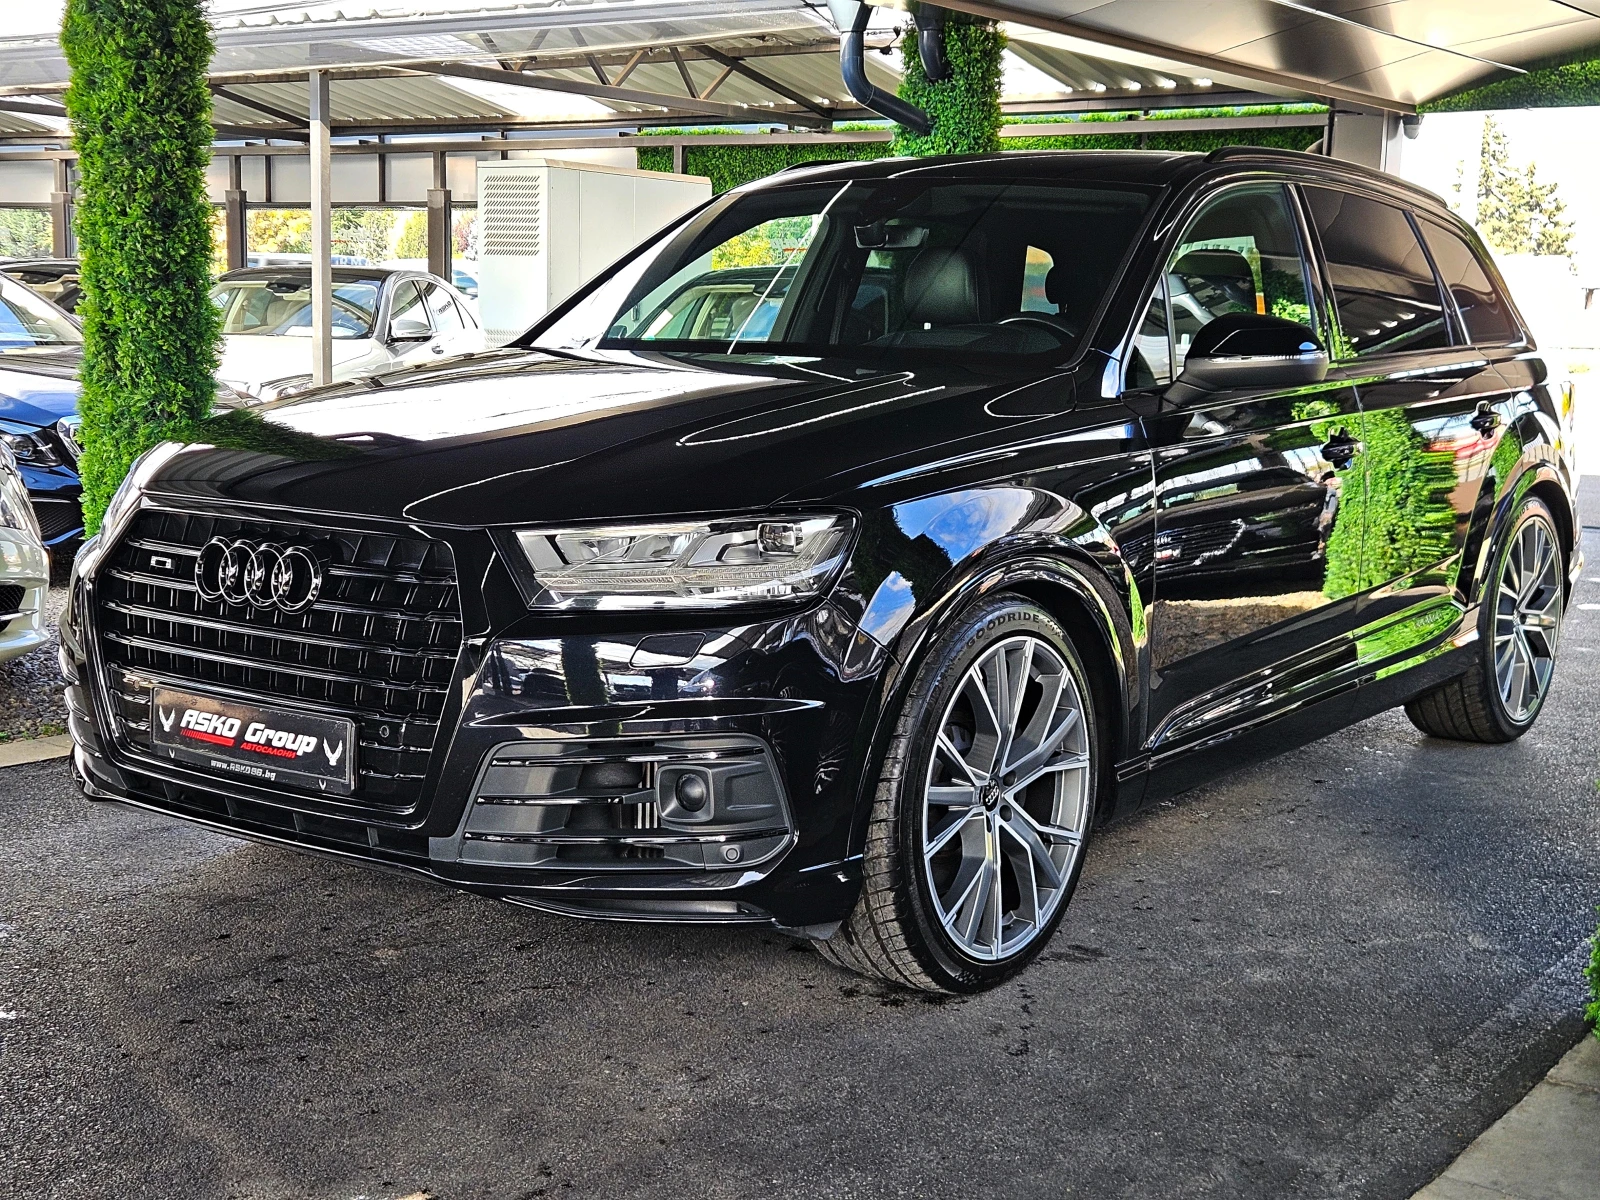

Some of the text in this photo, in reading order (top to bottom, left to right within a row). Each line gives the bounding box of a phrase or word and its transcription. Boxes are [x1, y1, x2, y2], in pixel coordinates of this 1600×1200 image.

[966, 611, 1040, 647] GOODRIDE
[181, 709, 318, 756] ASKO Group
[240, 742, 296, 759] АВТОСАЛОНИ
